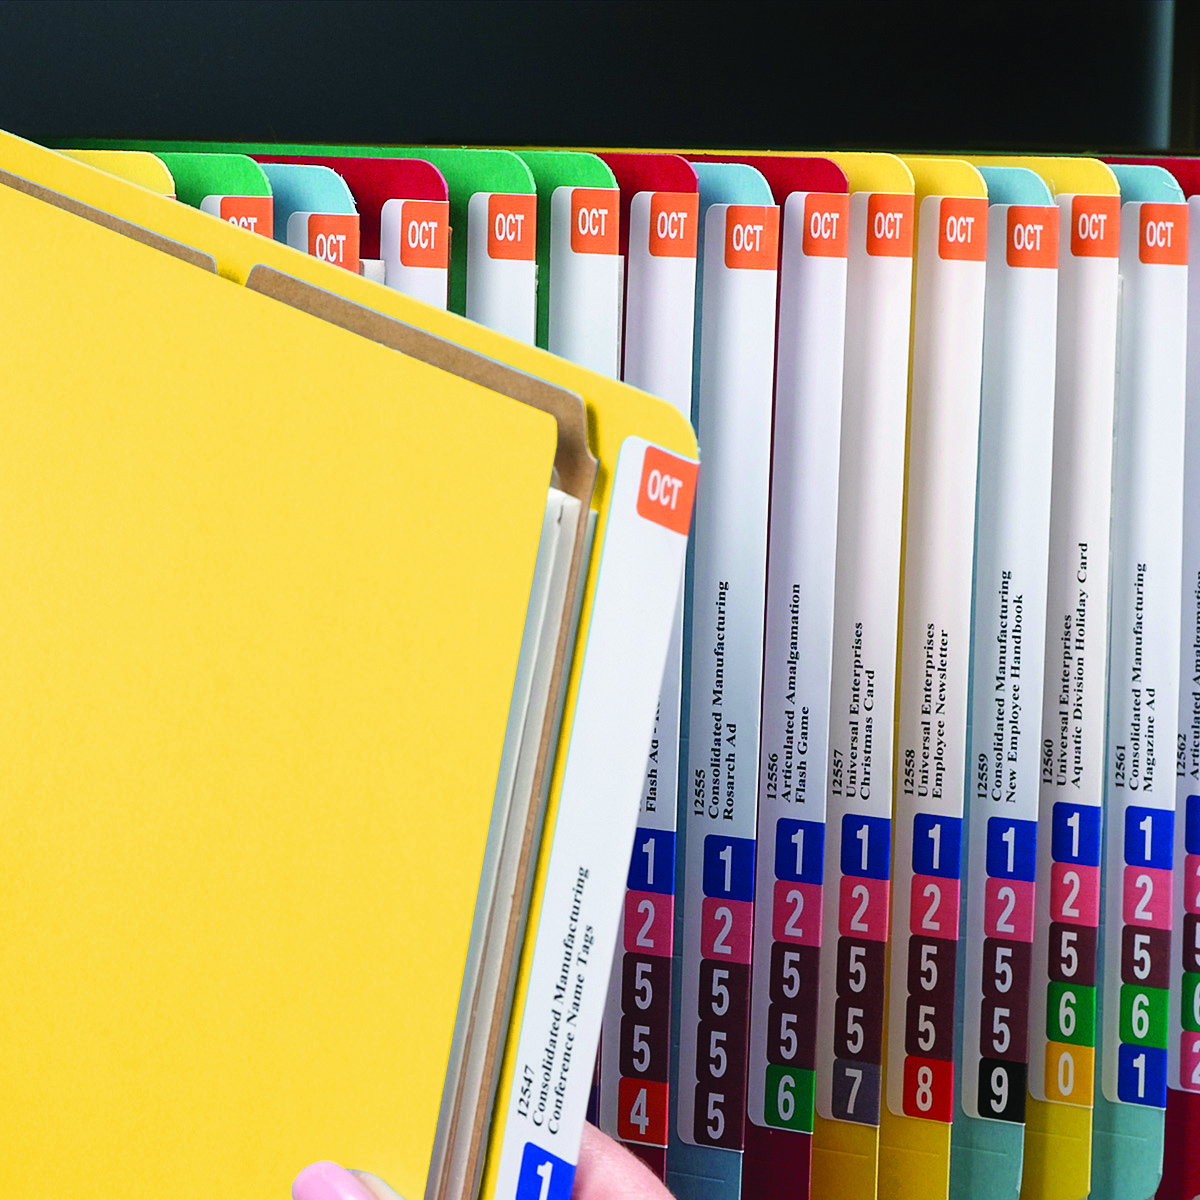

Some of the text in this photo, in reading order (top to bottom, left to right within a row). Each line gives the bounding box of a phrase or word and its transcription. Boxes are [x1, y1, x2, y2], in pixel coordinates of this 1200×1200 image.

[577, 206, 609, 237] OCT
[656, 210, 689, 240] OCT
[732, 223, 765, 253] OCT
[809, 211, 841, 240] OCT
[873, 211, 905, 240] OCT
[945, 215, 976, 244] OCT
[1013, 223, 1045, 252] OCT
[1077, 212, 1108, 241] OCT
[1145, 220, 1175, 249] OCT
[646, 468, 684, 511] OCT
[990, 569, 1013, 803] Consolidated Manufacturing
[1070, 542, 1090, 790] Aquatic Division Holiday Card
[1128, 562, 1147, 792] Consolidated Manufacturing
[707, 580, 730, 820] Consolidated Manufacturing
[780, 583, 801, 804] Articulated Amalgamation
[845, 621, 865, 799] Universal Enterprises
[917, 622, 937, 798] Universal Enterprises
[931, 628, 949, 800] Employee Newsletter
[1004, 593, 1024, 804] New Employee Handbook
[1055, 614, 1074, 787] Universal Enterprises
[794, 705, 810, 805] Flash Game
[858, 669, 876, 802] Christmas Card
[1142, 687, 1157, 793] Magazine Ad
[722, 722, 738, 822] Rosarch Ad
[765, 752, 780, 801] 12556
[831, 748, 844, 797] 12557
[903, 748, 917, 796] 12558
[976, 752, 990, 800] 12559
[1042, 738, 1054, 786] 12560
[1114, 744, 1127, 789] 12561
[692, 768, 707, 818] 12555
[532, 866, 590, 1128] Consolidated Manufacturing
[547, 925, 595, 1136] Conference Name Tags
[516, 1063, 535, 1118] 12547
